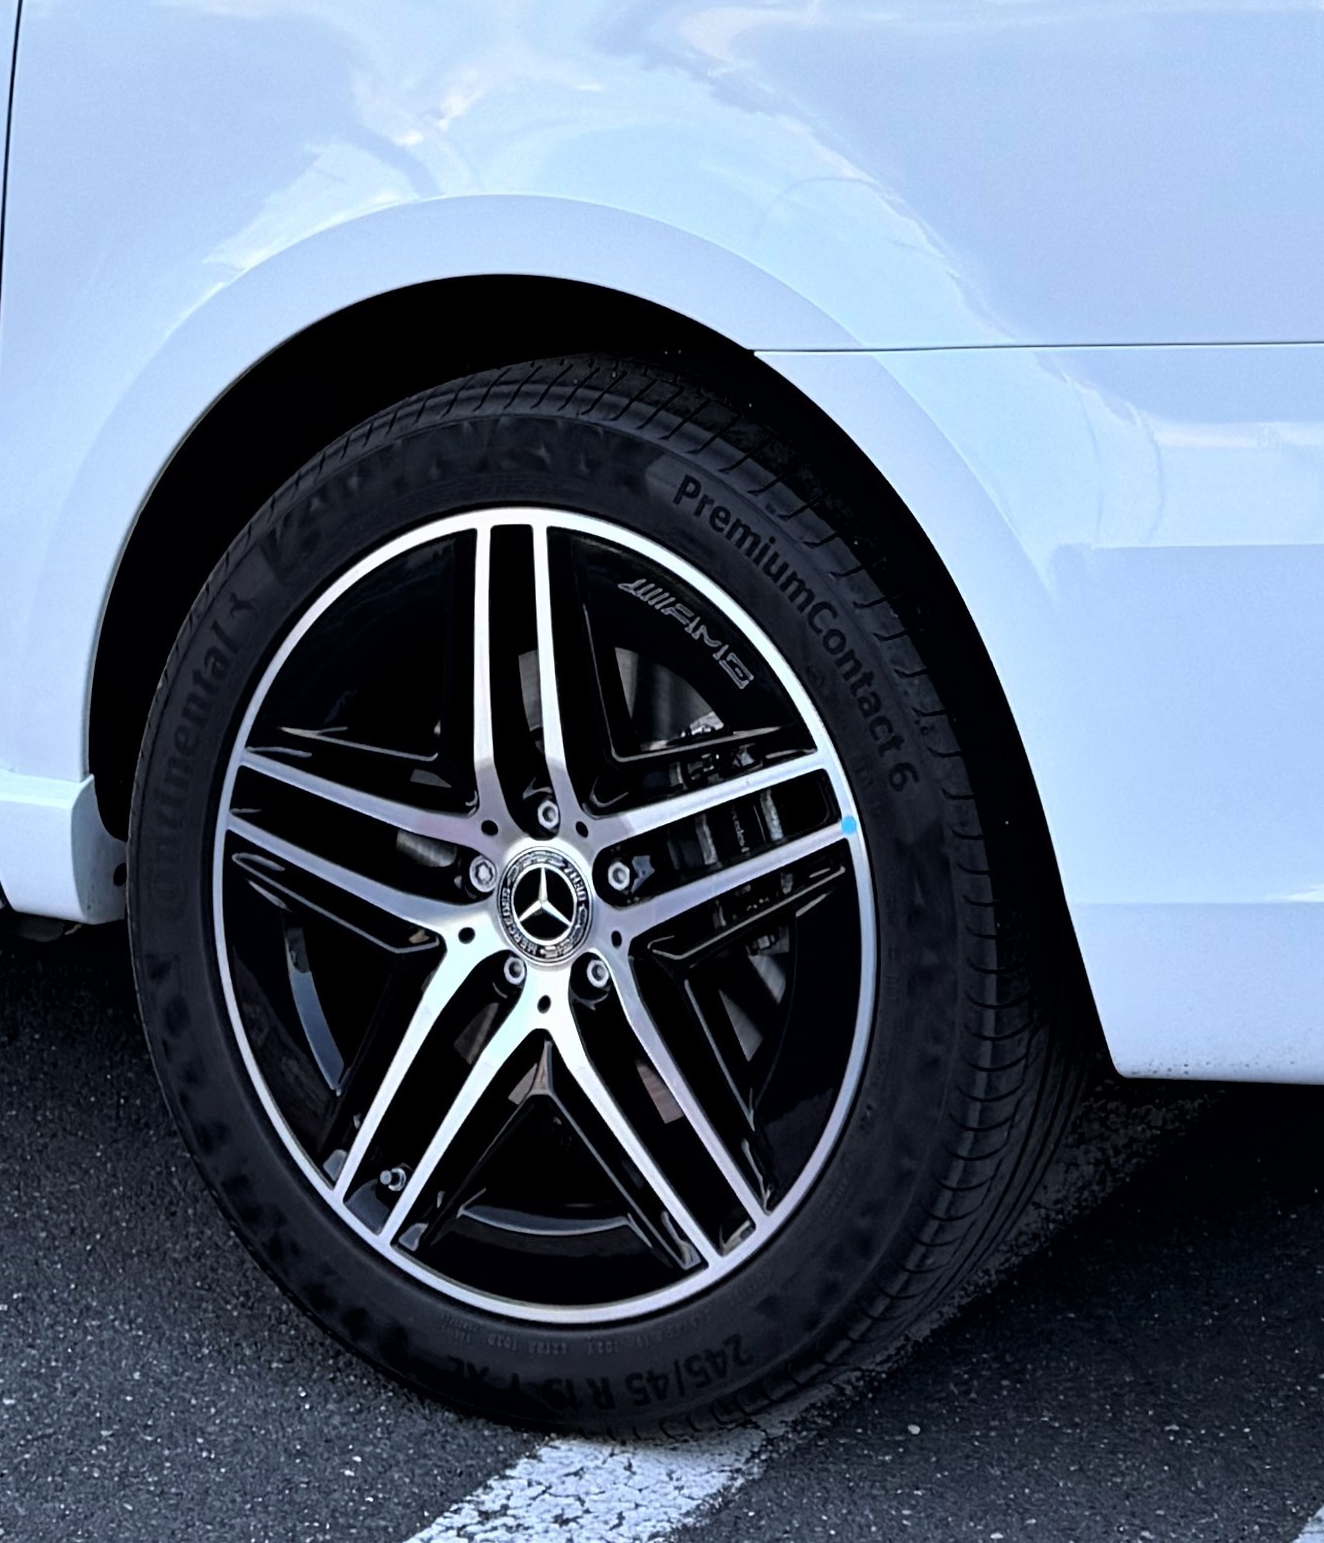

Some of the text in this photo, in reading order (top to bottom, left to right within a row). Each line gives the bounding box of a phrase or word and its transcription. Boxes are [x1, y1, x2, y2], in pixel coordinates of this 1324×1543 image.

[673, 474, 920, 793] PremiumContact 6
[586, 1376, 615, 1409] R
[625, 1332, 754, 1407] 245/45
